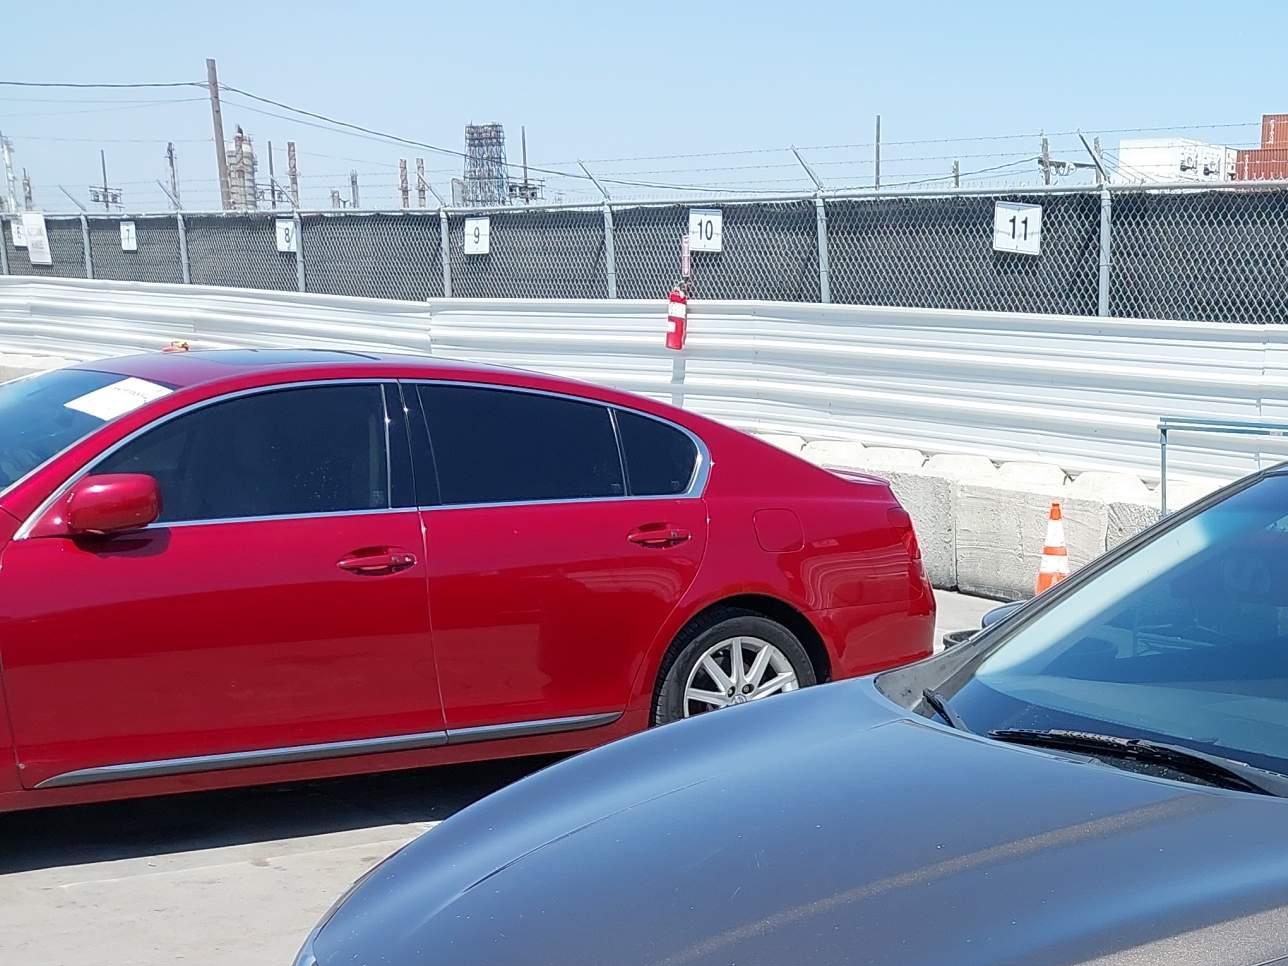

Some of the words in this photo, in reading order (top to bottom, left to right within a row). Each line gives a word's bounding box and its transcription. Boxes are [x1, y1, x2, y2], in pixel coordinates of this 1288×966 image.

[284, 227, 291, 243] 8
[473, 226, 480, 244] 9
[697, 219, 713, 241] 10
[1009, 215, 1028, 241] 11
